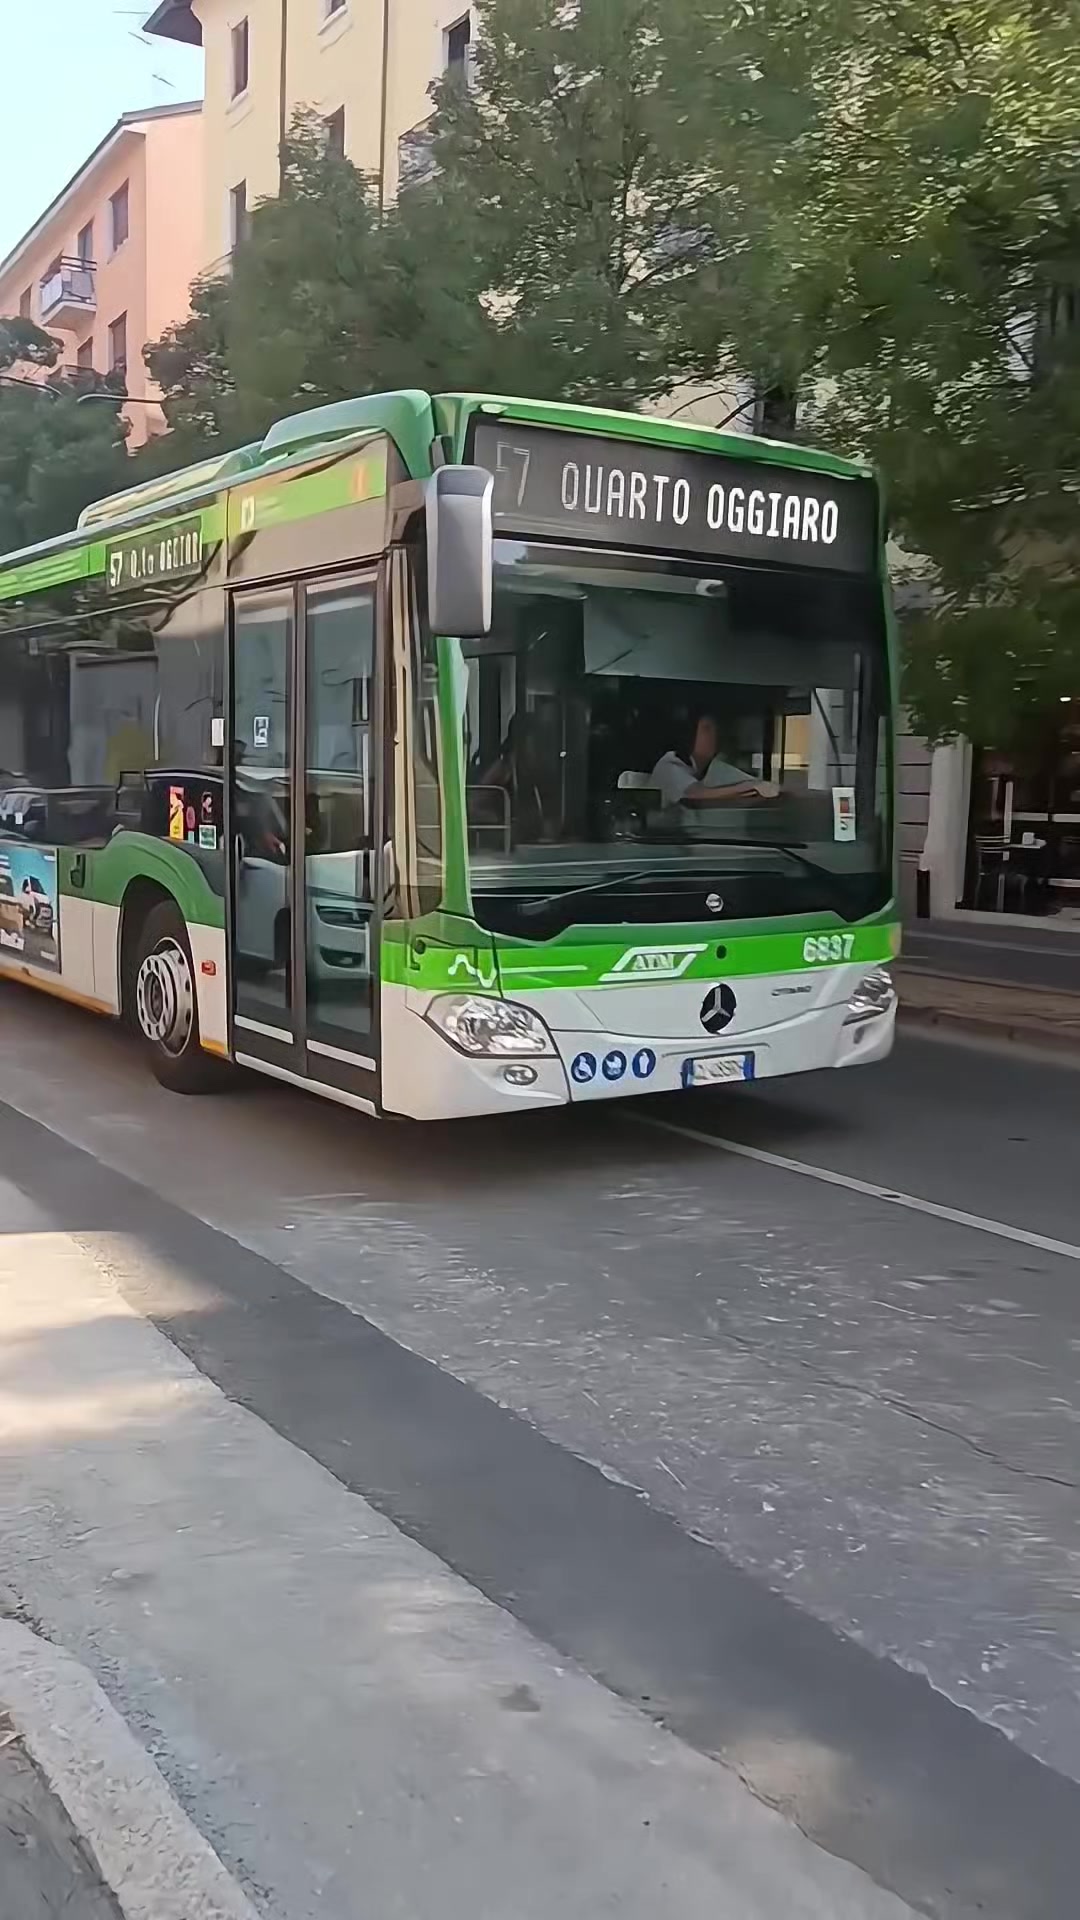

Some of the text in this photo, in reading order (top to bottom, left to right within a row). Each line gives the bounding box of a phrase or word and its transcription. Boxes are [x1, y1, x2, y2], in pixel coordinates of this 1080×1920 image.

[561, 461, 690, 526] QUARTO
[706, 483, 839, 545] OGGIARO
[110, 551, 123, 587] 57
